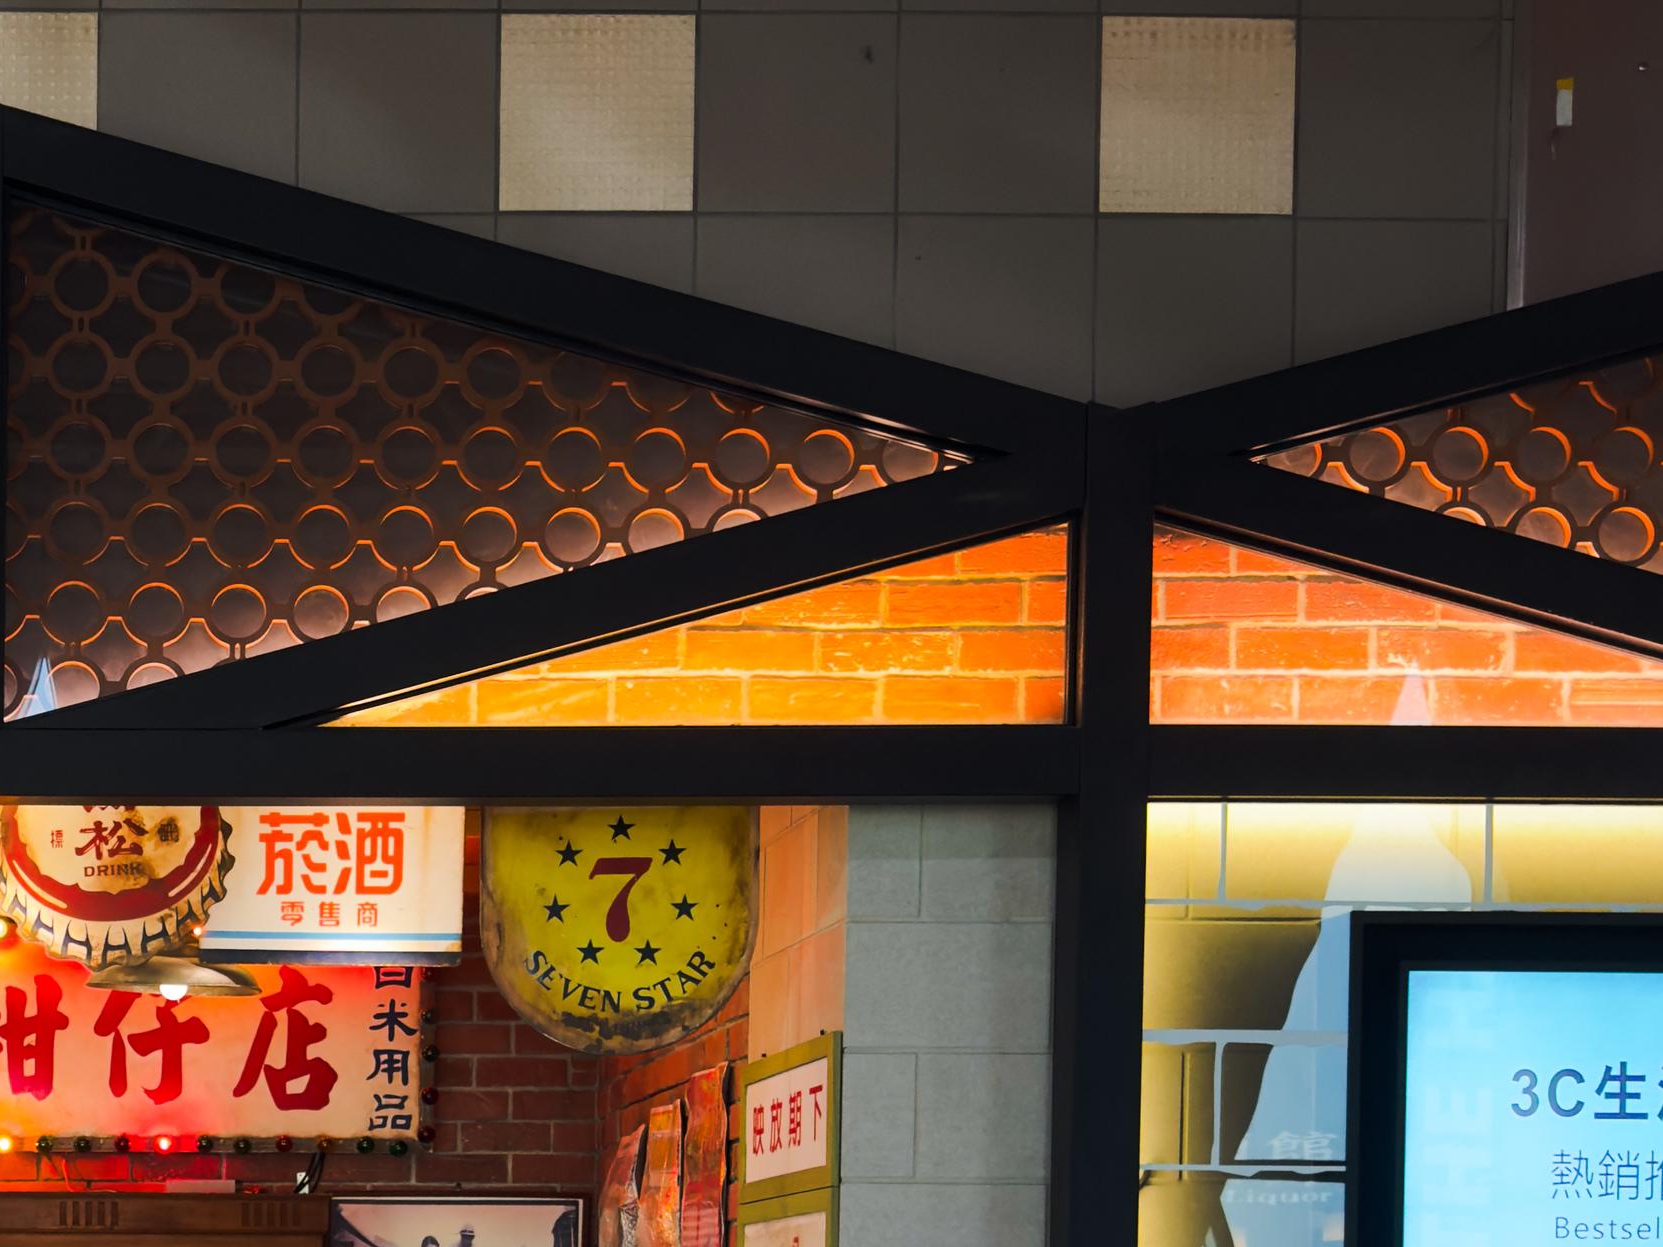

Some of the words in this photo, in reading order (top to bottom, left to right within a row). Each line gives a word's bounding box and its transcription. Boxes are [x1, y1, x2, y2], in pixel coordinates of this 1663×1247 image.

[84, 864, 144, 878] DRINK
[257, 811, 406, 896] 菸酒
[279, 900, 379, 927] 零售商
[588, 856, 654, 943] 7
[523, 949, 621, 1014] SEVEN
[632, 949, 716, 1011] STAR
[1511, 1060, 1663, 1121] 3C生
